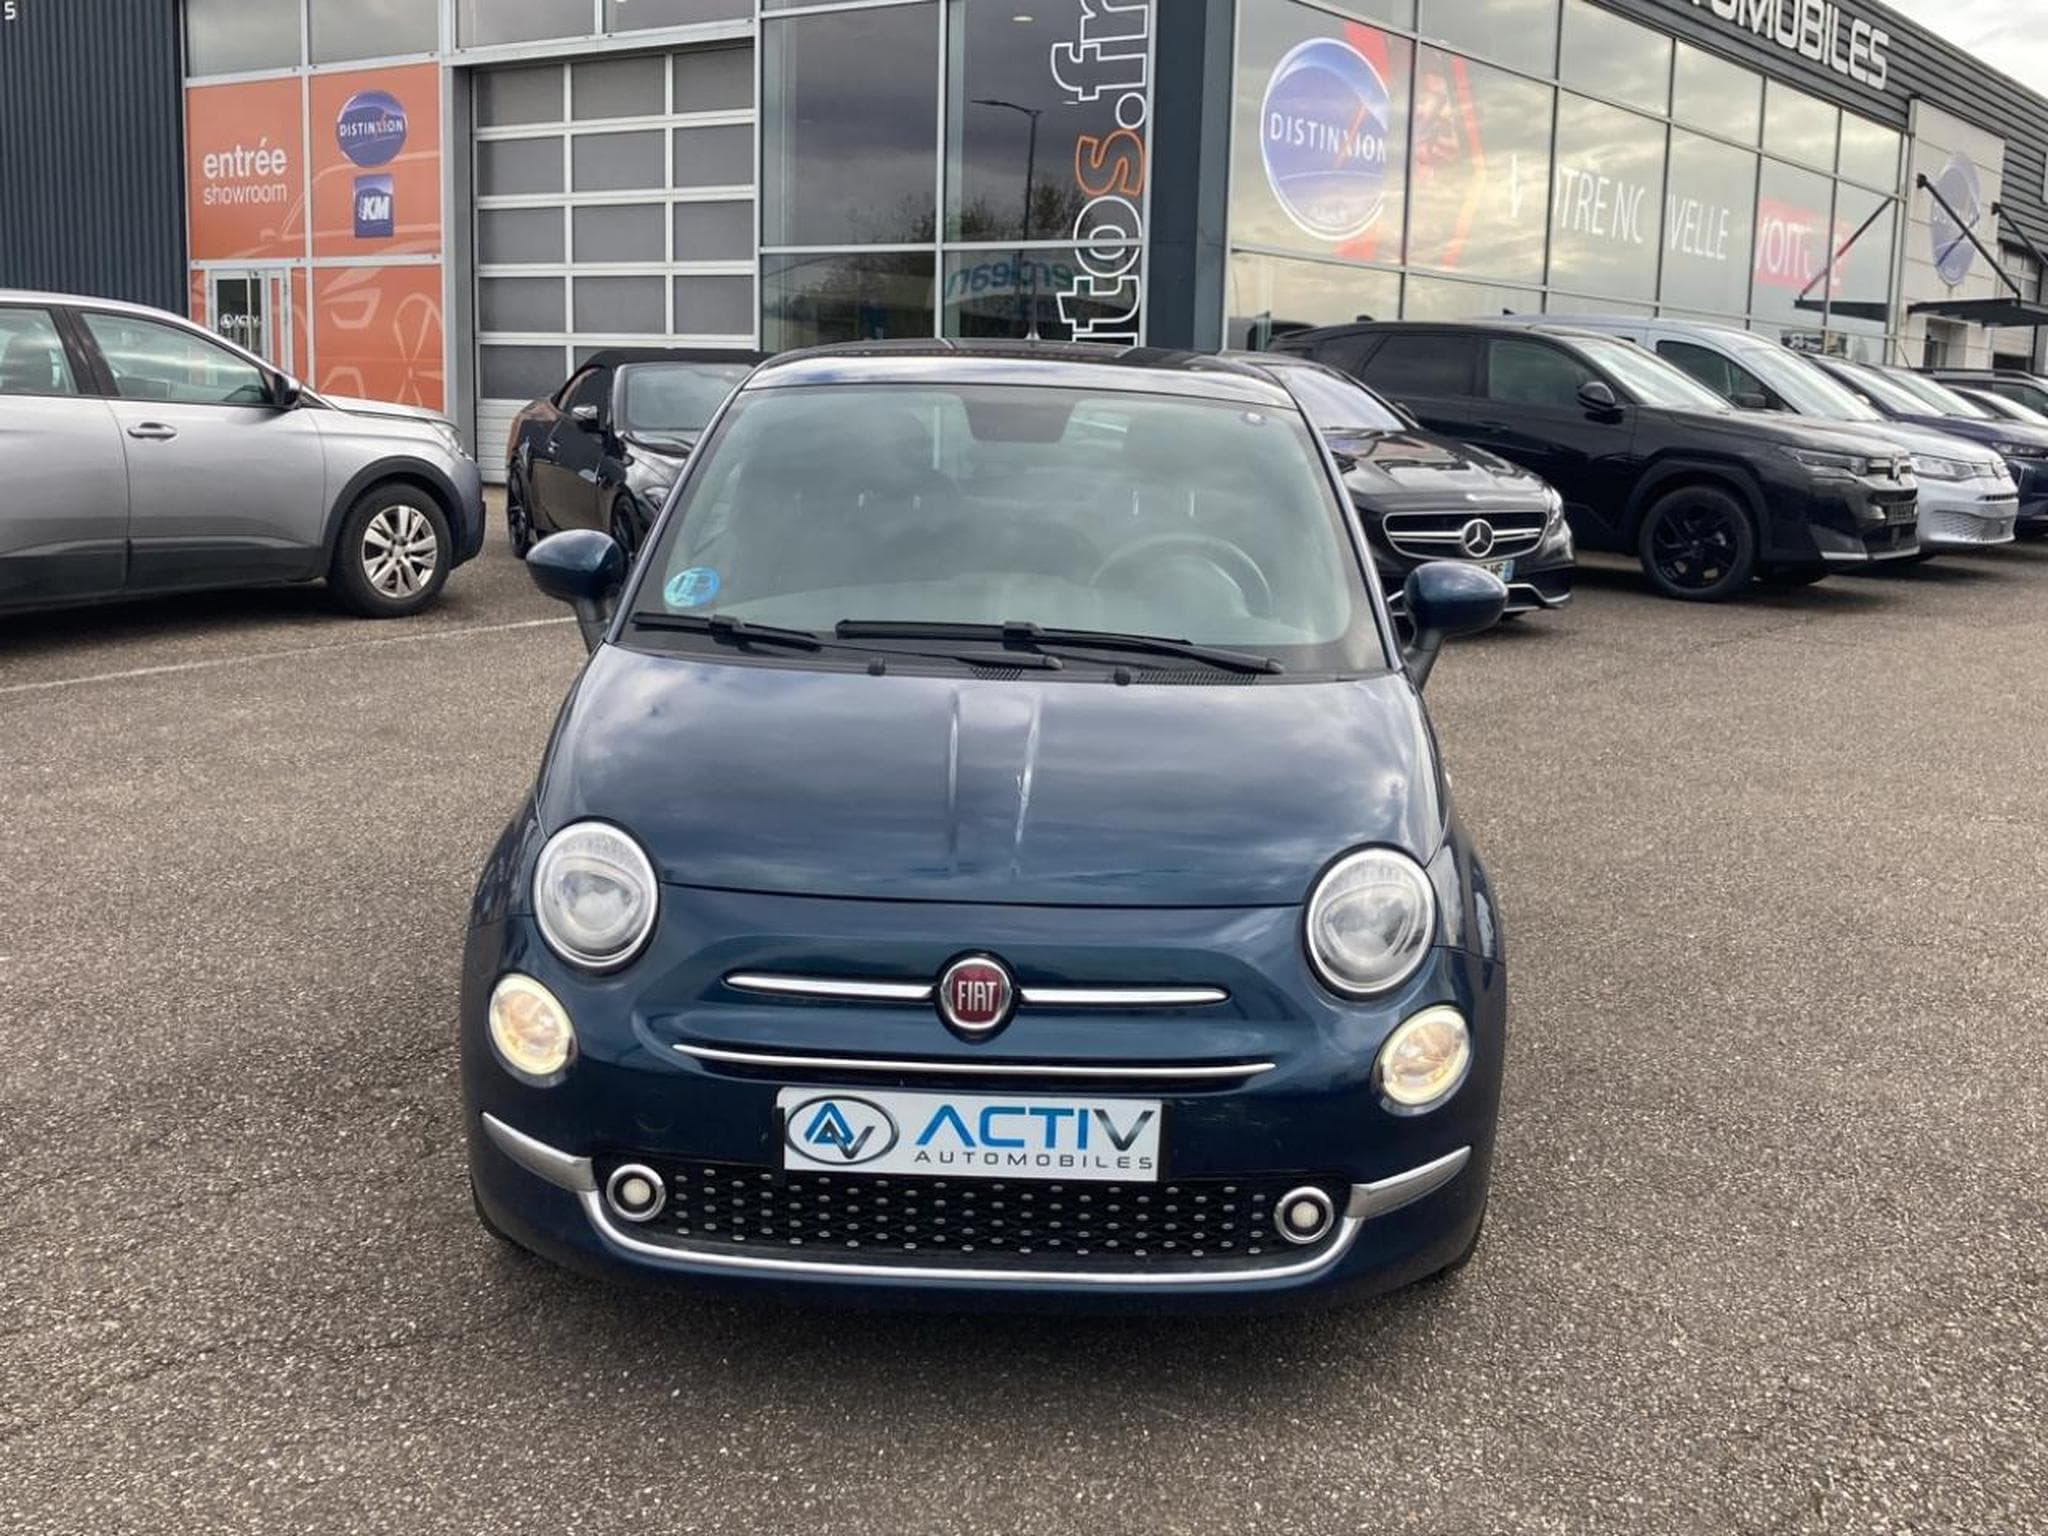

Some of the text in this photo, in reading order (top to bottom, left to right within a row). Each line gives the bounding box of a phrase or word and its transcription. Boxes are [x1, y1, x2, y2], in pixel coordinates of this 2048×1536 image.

[1691, 0, 1889, 91] MOBILES
[203, 137, 287, 179] entrée
[1051, 0, 1149, 346] tos.fr
[203, 183, 287, 206] showroom
[1511, 152, 1612, 237] VTRE
[1610, 180, 1731, 261] NVELLE
[957, 980, 998, 1012] FIAT
[915, 1103, 1155, 1151] ACTIV
[914, 1150, 1153, 1169] AUTOMOBILES
